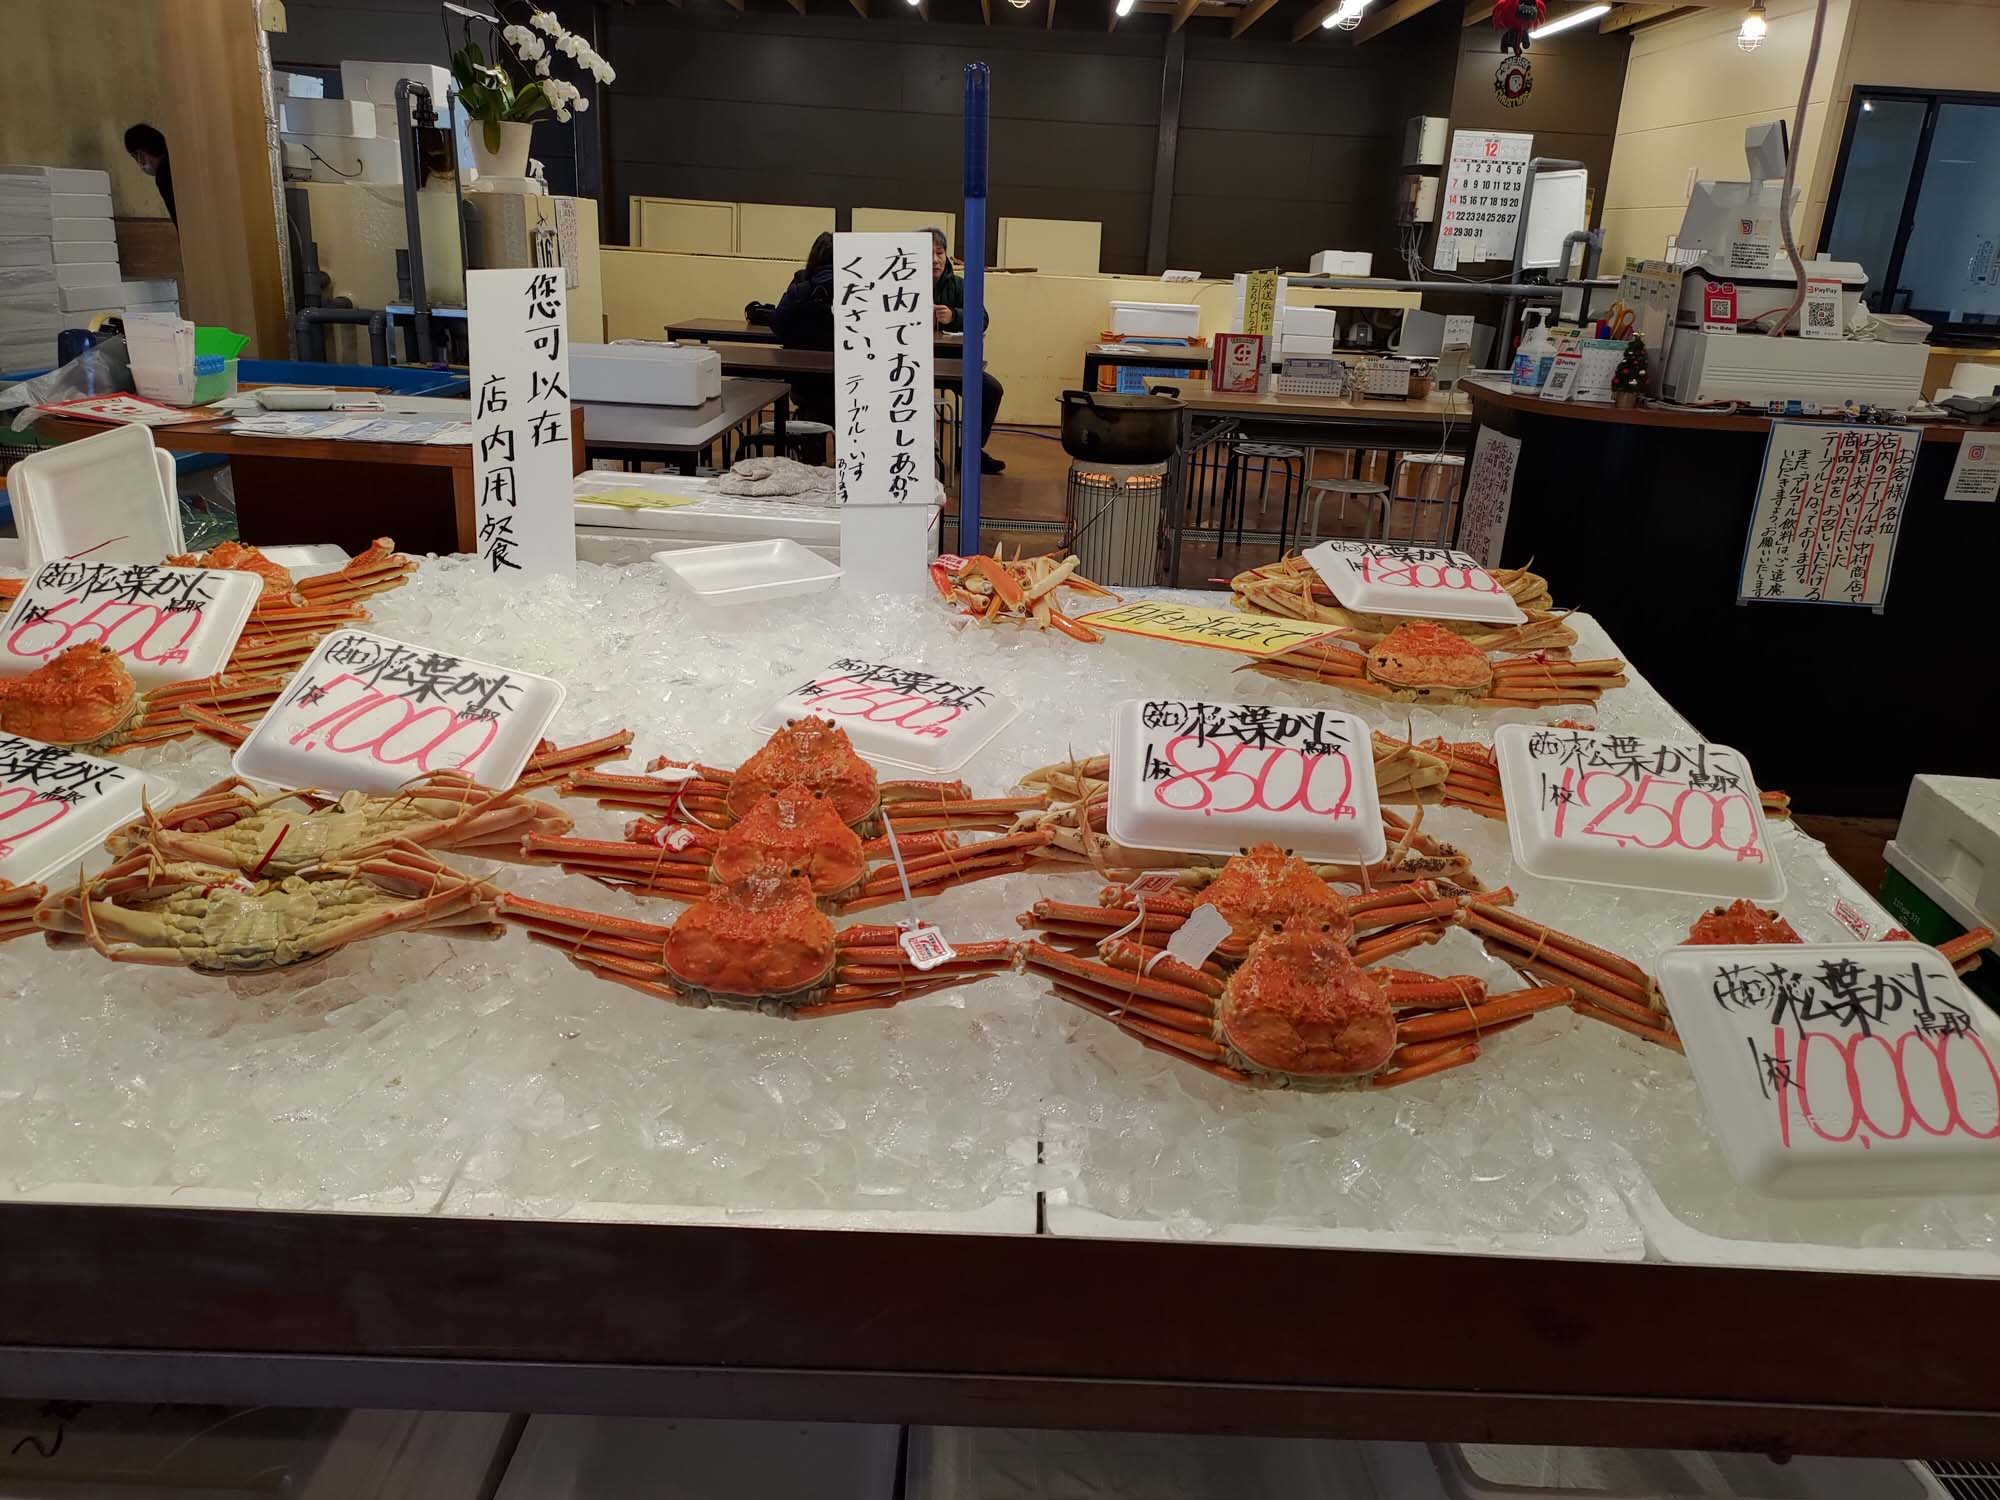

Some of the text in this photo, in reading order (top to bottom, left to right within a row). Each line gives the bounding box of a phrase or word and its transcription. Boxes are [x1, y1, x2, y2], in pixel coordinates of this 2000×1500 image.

[1466, 163, 1522, 175] 1 2 3 4 5 6
[1484, 142, 1498, 157] 12
[1449, 195, 1519, 208] 14 15 16 17 18 19 20
[1452, 179, 1520, 191] 7 8 9 10 11 12 13
[1443, 227, 1483, 238] 28 29 30 31
[1446, 211, 1516, 223] 21 22 23 24 25 26 27
[841, 256, 876, 361] ください。
[525, 274, 569, 449] 您可以在
[477, 374, 523, 573] 店内用餐
[289, 673, 498, 778] 7,000
[802, 676, 962, 739] 7,500円
[1154, 734, 1357, 821] 8,500円
[1553, 767, 1765, 865] 12,500円
